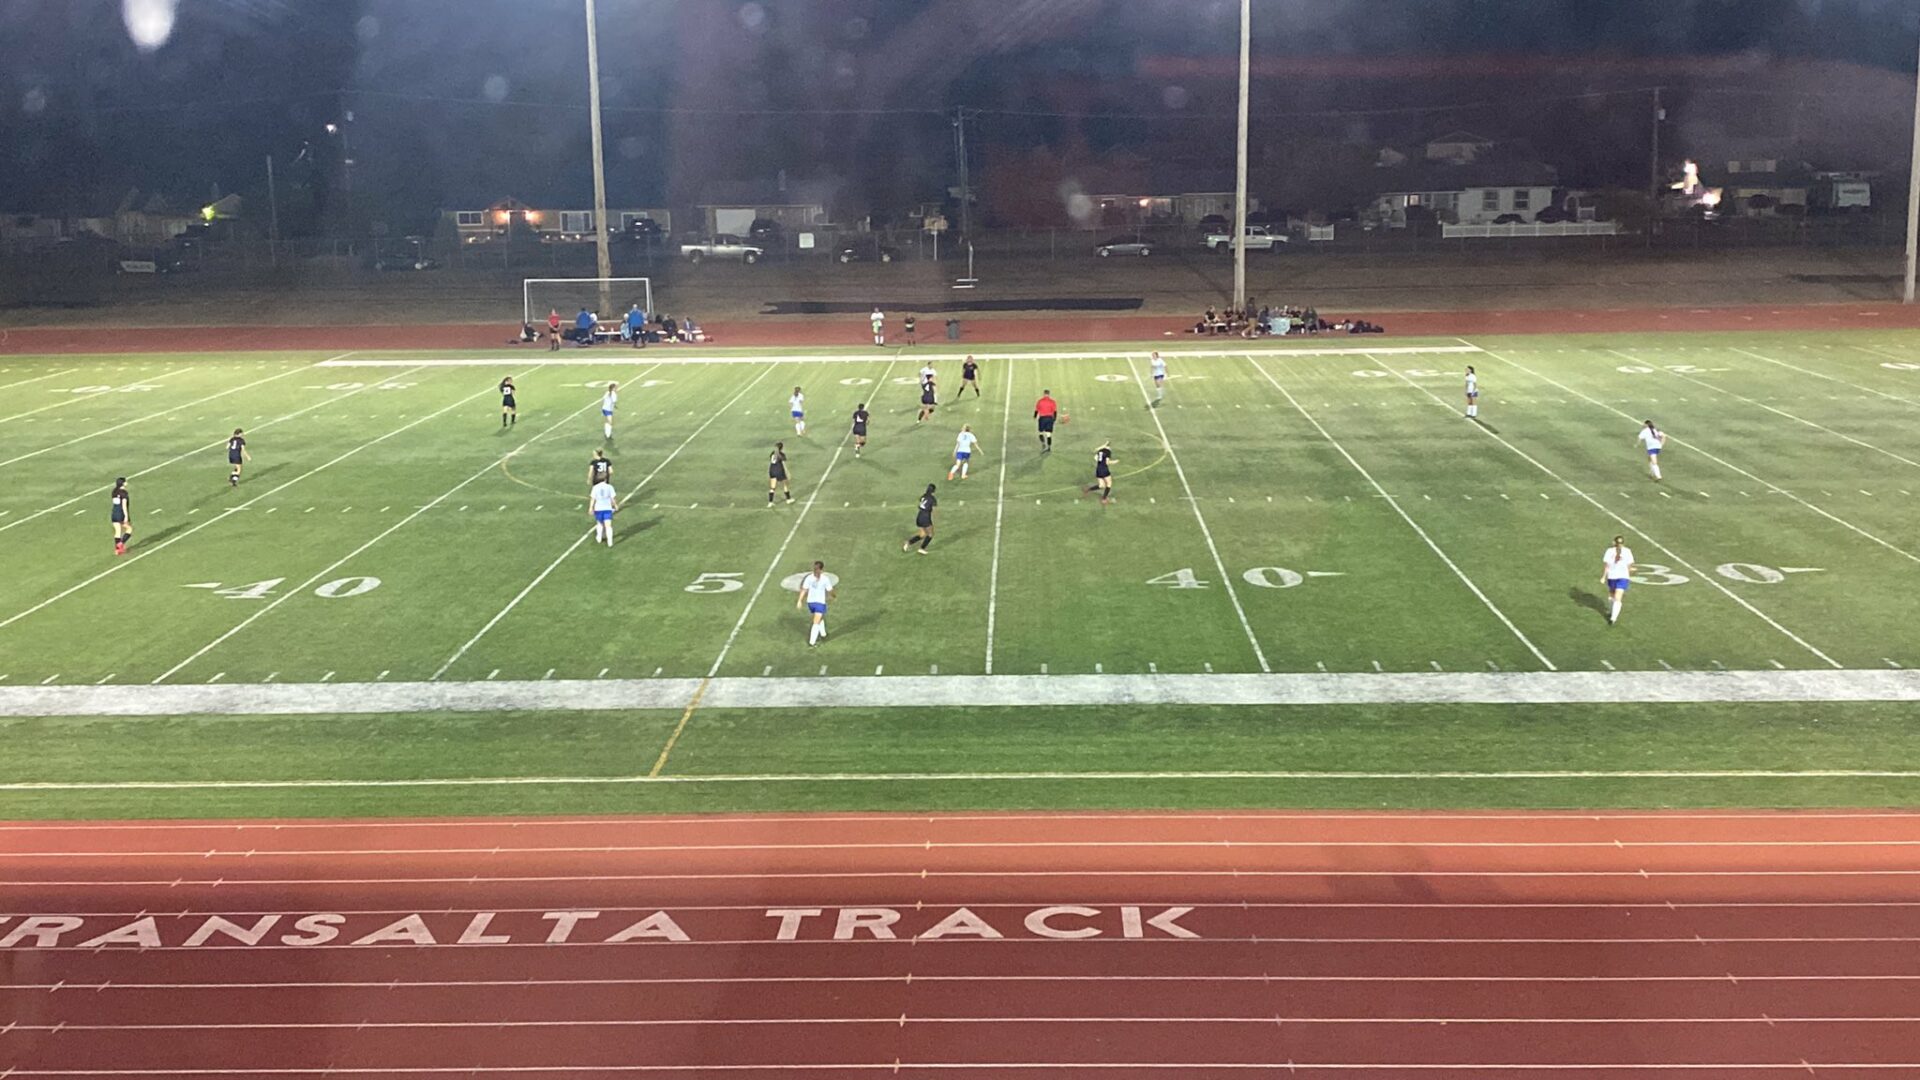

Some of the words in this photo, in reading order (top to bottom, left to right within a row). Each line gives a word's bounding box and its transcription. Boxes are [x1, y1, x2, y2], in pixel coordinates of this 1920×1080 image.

[597, 462, 607, 473] 31
[213, 577, 382, 598] 40
[1146, 567, 1303, 588] 40
[765, 906, 1202, 941] TRACK
